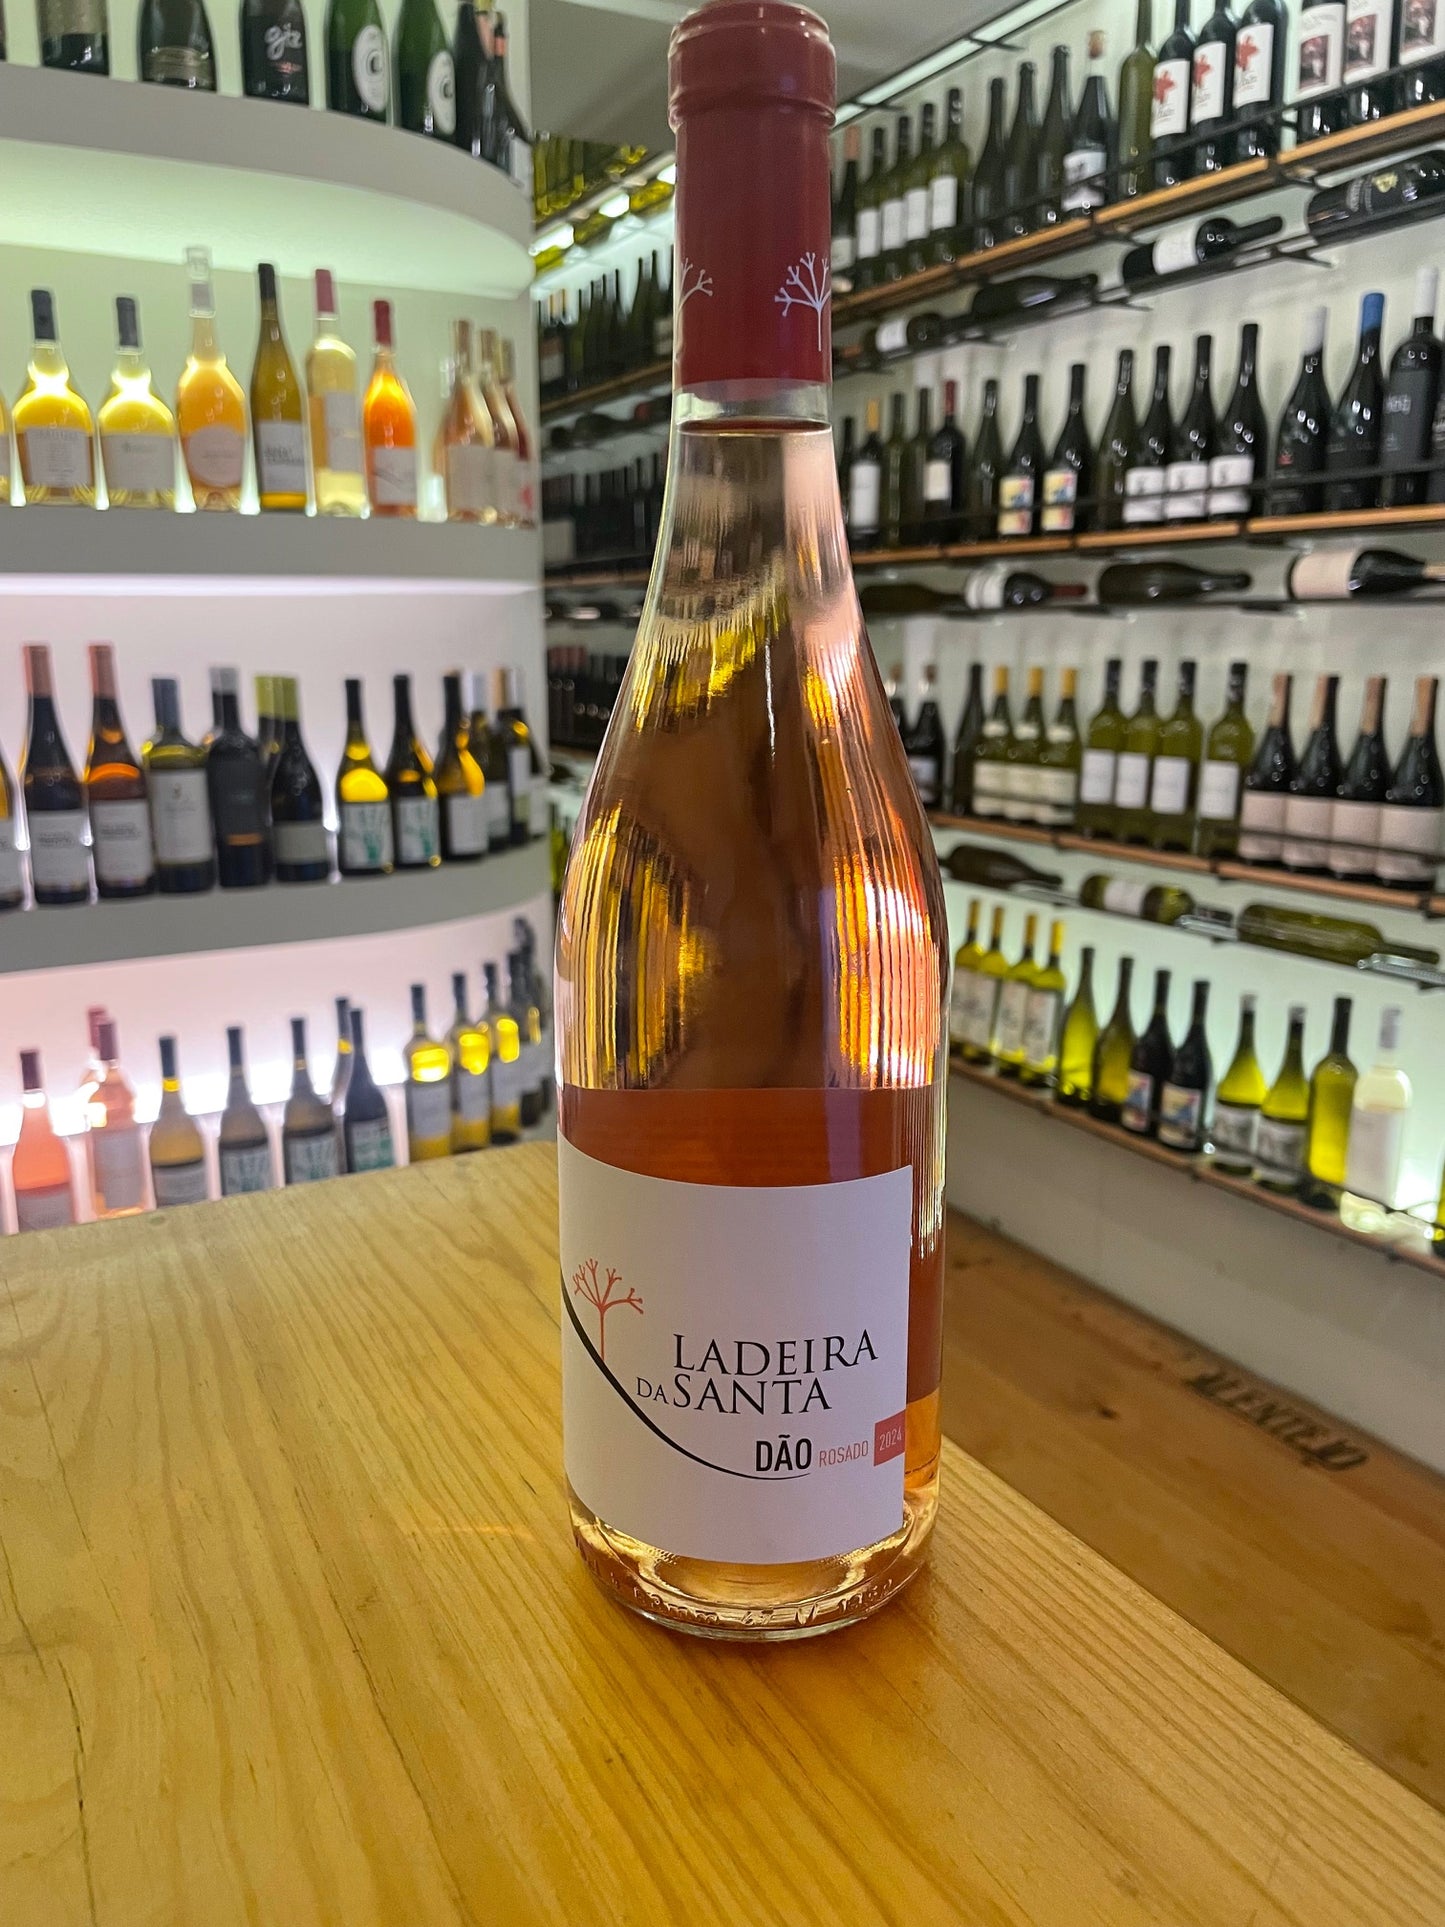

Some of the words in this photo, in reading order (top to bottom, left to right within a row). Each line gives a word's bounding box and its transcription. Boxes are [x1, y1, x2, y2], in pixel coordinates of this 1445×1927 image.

[673, 1329, 879, 1376] LADEIRA
[636, 1377, 669, 1404] DA
[673, 1373, 832, 1415] SANTA
[756, 1434, 812, 1472] DÃO
[819, 1440, 869, 1468] ROSADO
[879, 1426, 902, 1451] 2024
